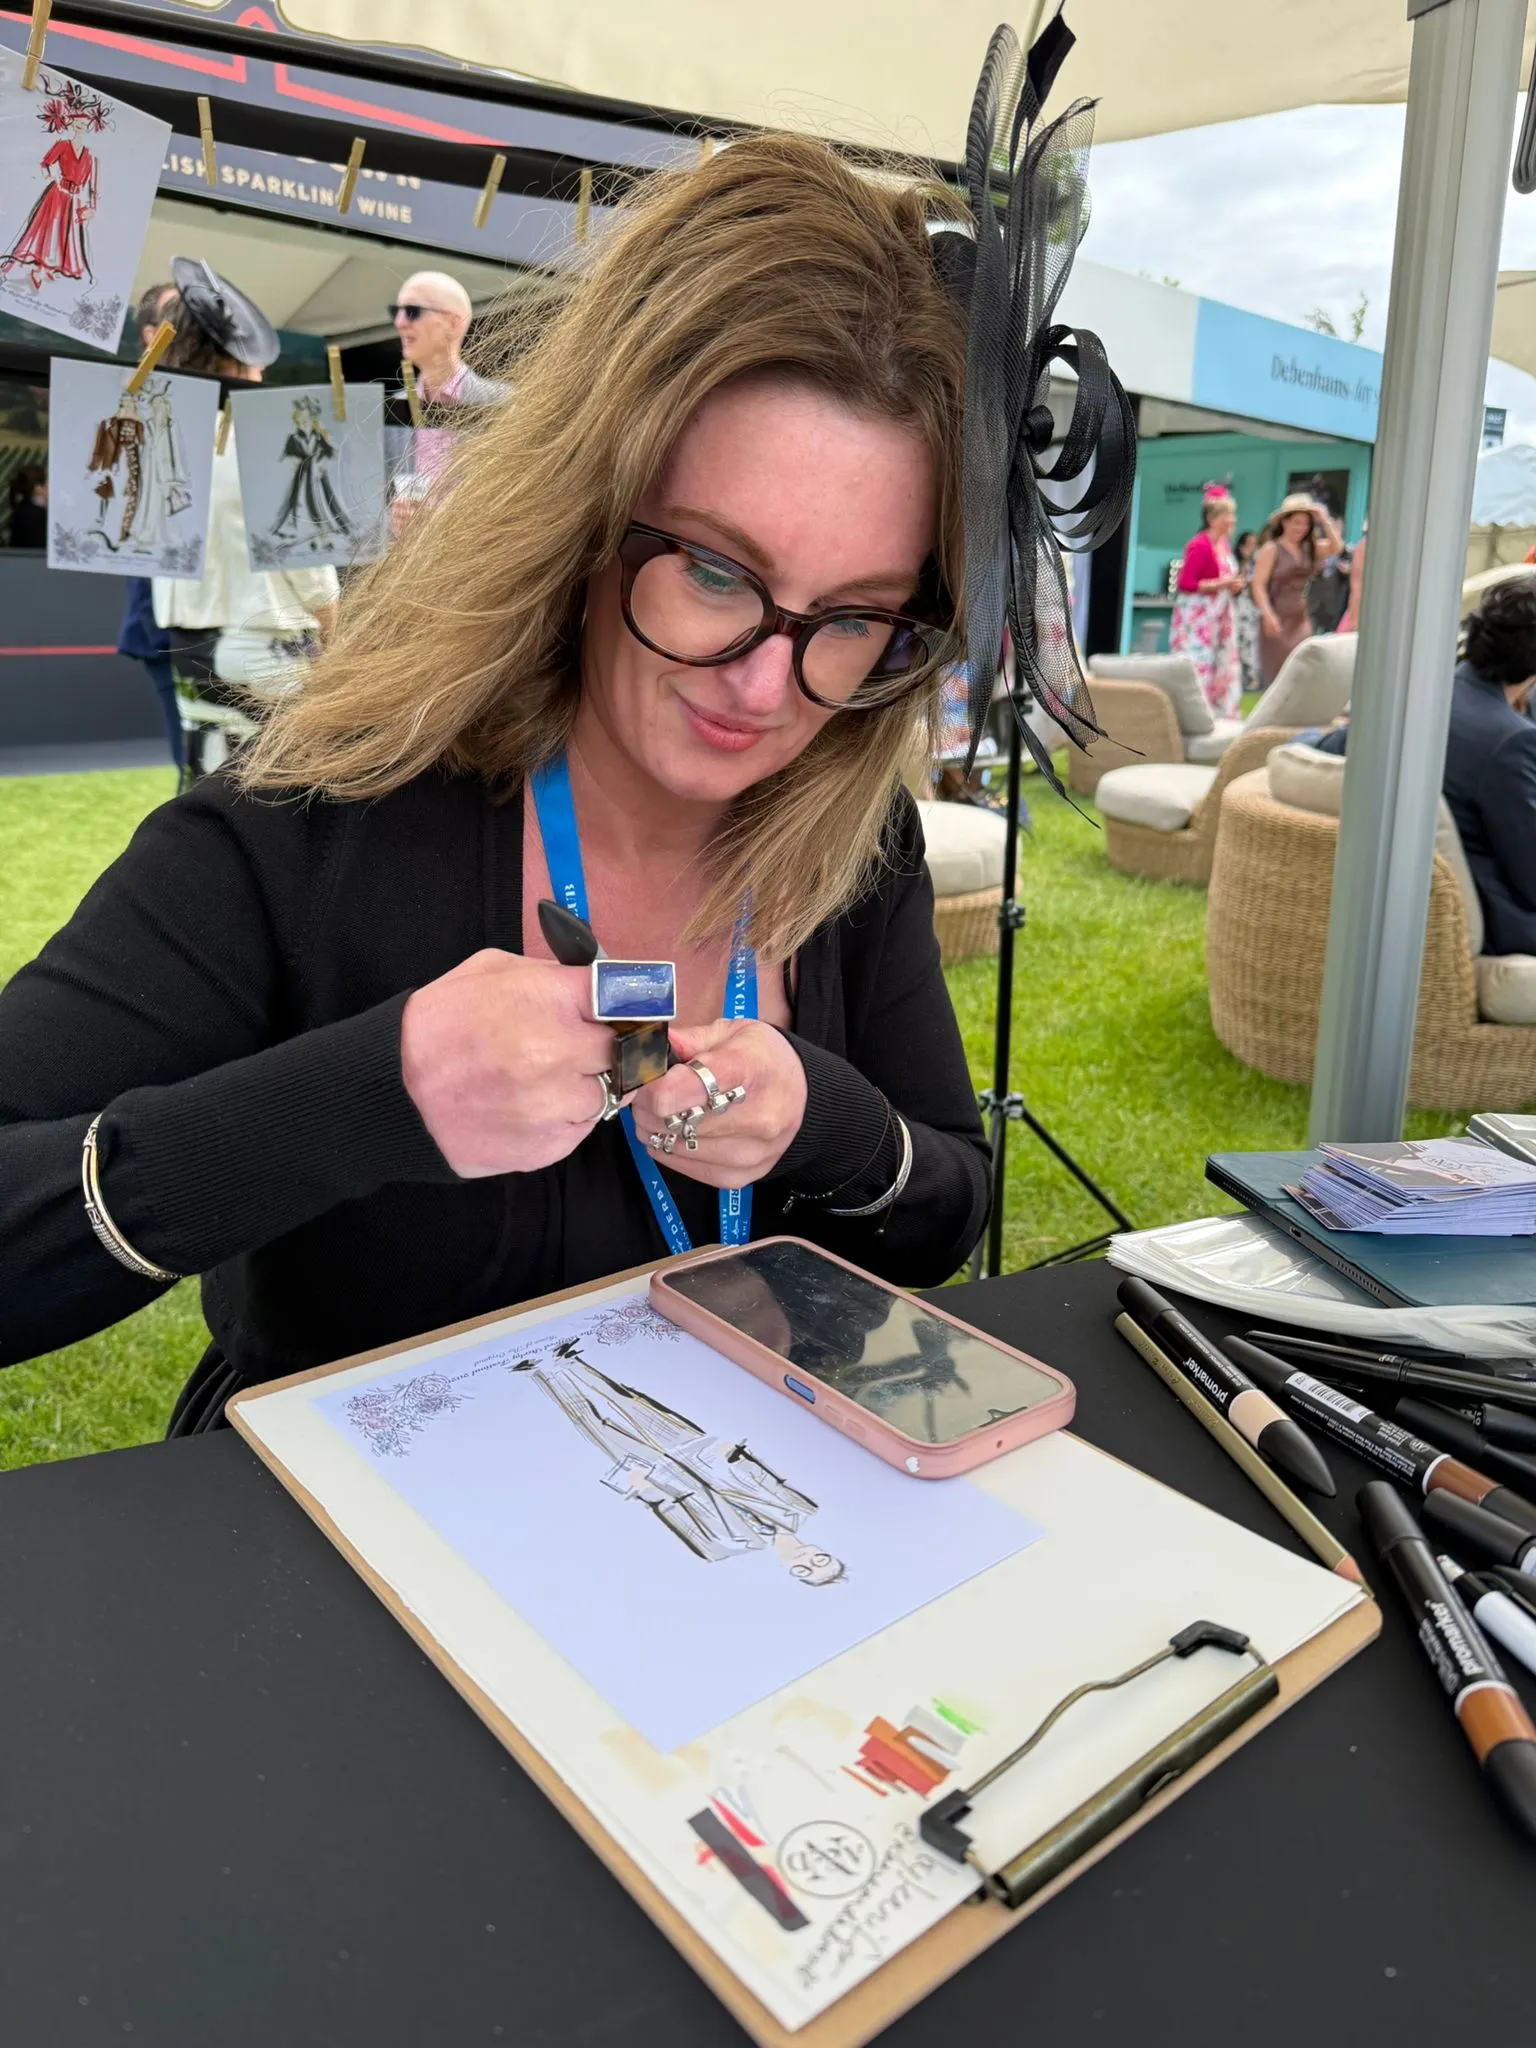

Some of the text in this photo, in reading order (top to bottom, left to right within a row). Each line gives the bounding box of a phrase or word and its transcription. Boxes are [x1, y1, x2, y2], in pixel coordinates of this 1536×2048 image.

[221, 165, 341, 208] SPARKLIN
[356, 195, 413, 225] WINE
[1271, 353, 1349, 400] Debenhams
[650, 1180, 678, 1235] DERBY
[1183, 1357, 1228, 1403] promarker
[1430, 1602, 1485, 1677] promarker
